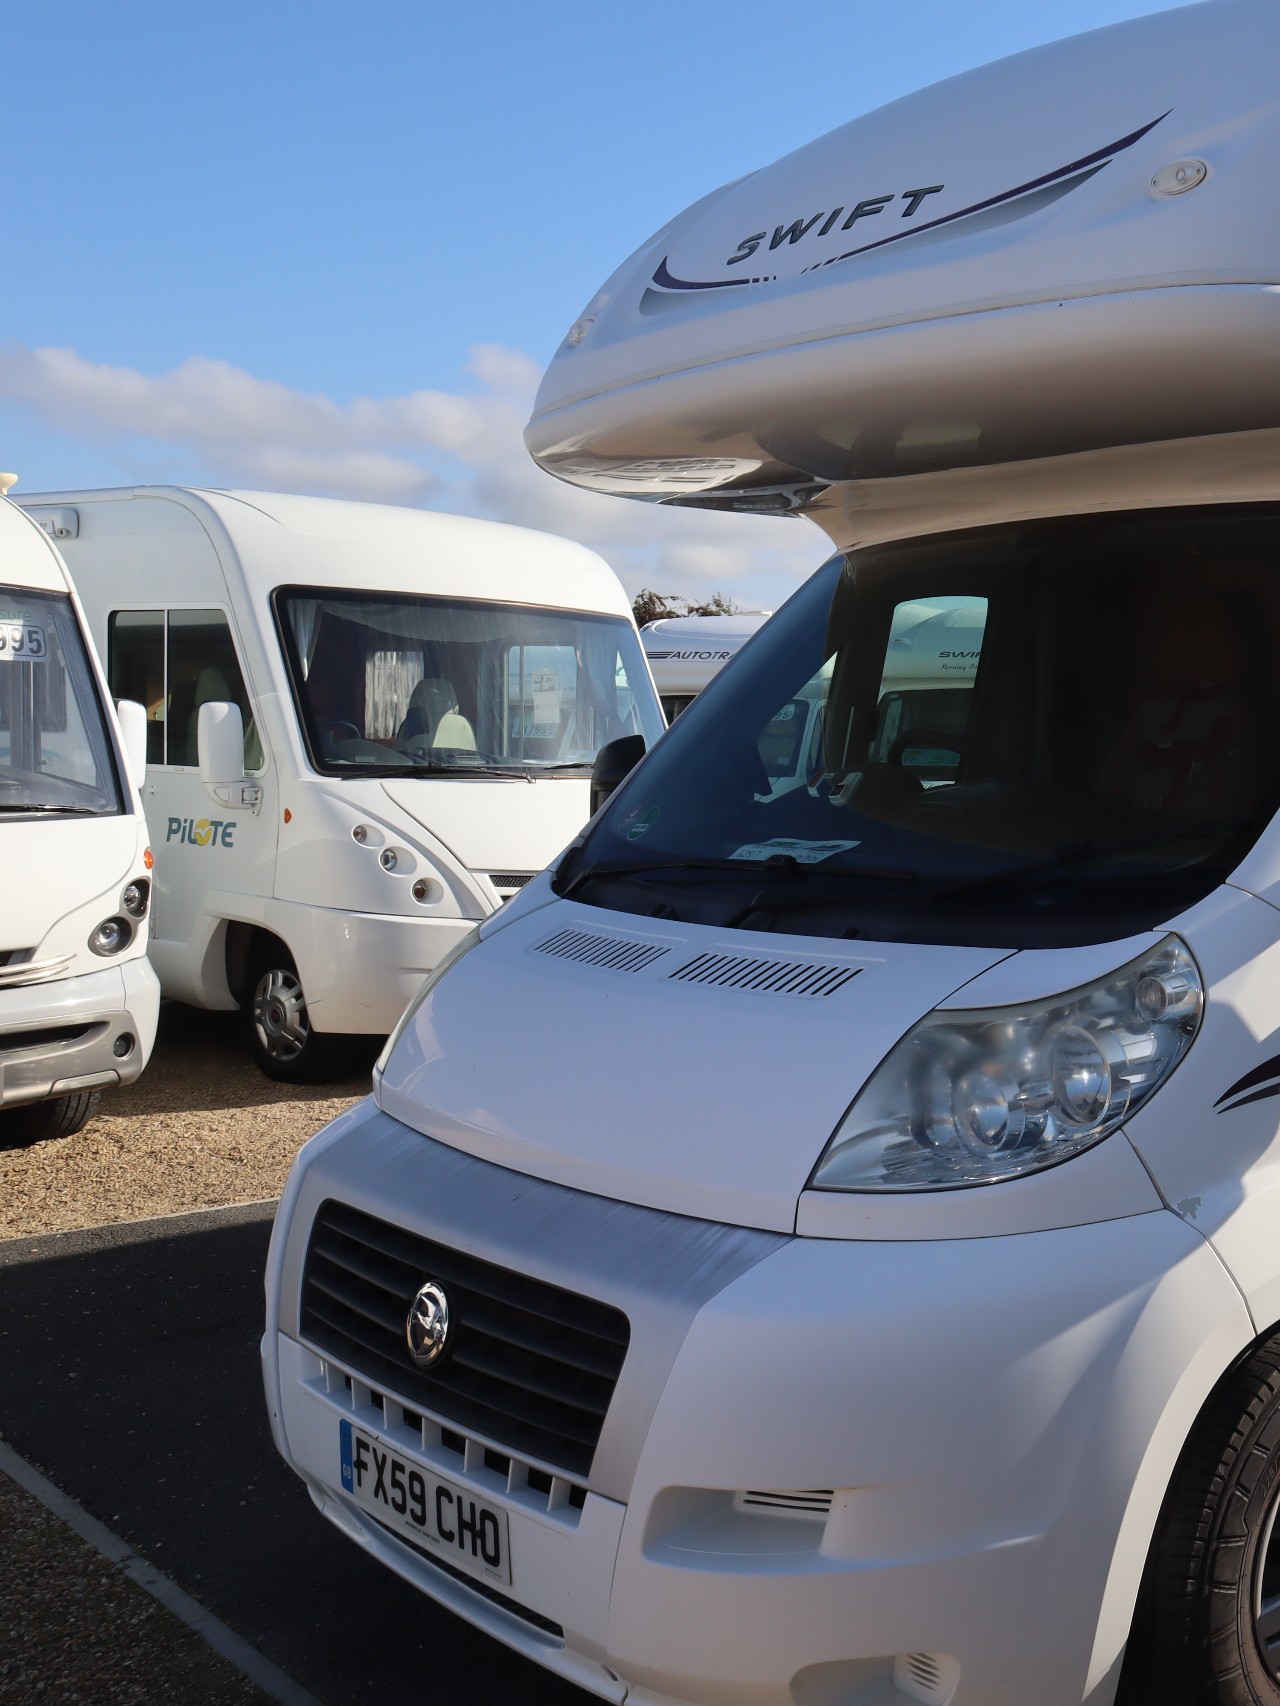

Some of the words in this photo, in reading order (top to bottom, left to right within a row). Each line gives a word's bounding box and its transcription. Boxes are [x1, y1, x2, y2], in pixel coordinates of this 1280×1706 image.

[727, 185, 945, 266] SWIFT
[342, 1463, 352, 1480] GB
[354, 1436, 427, 1527] FX59
[435, 1485, 501, 1568] CHO
